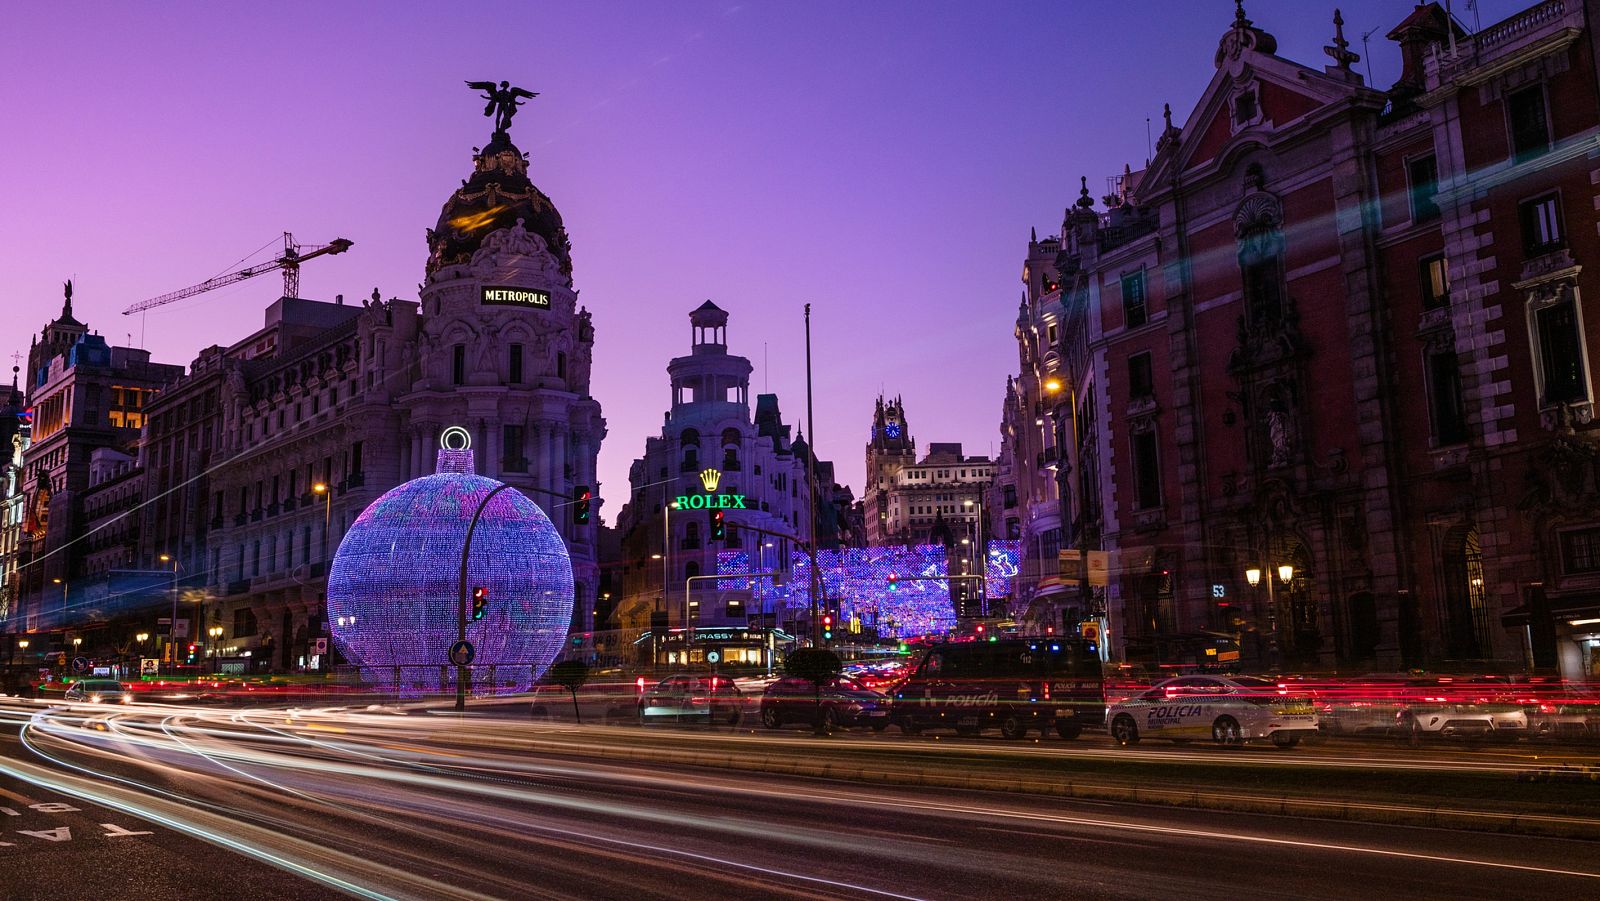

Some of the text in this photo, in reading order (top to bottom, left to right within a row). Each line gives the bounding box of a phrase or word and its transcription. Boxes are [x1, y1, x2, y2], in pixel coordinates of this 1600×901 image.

[485, 290, 549, 305] METROPOLIS
[675, 494, 746, 510] ROLEX
[1212, 584, 1225, 598] 53
